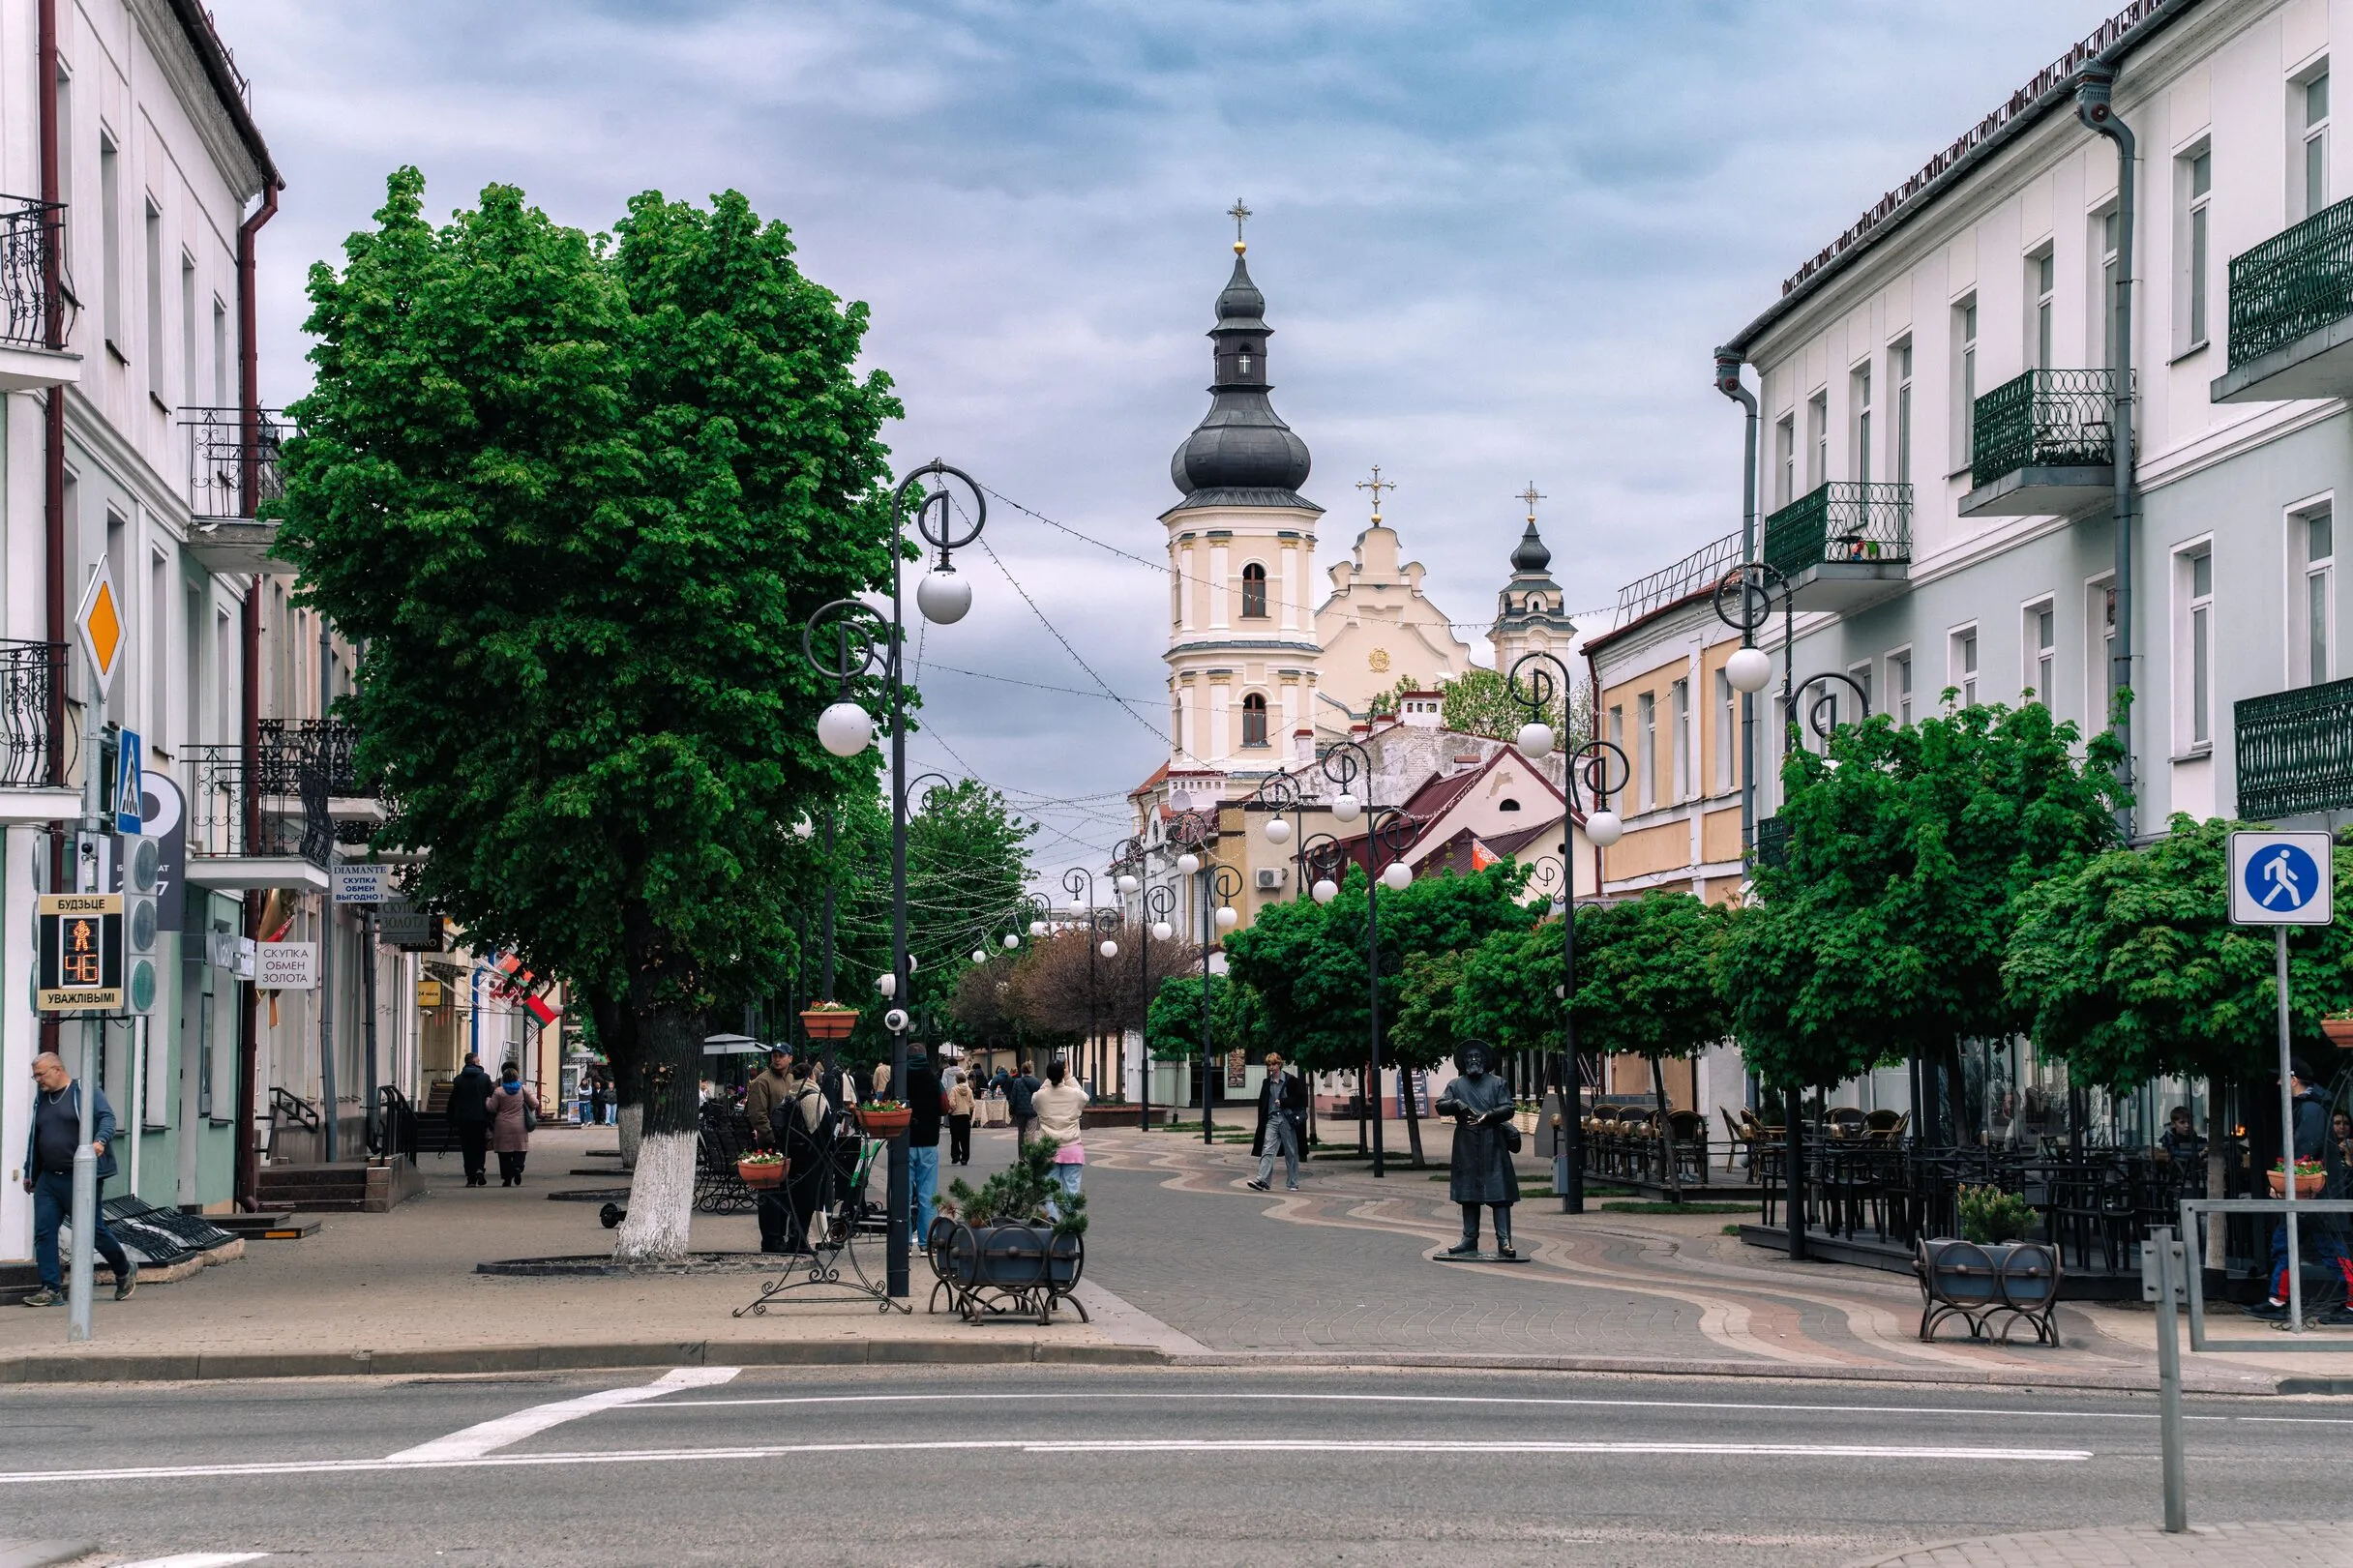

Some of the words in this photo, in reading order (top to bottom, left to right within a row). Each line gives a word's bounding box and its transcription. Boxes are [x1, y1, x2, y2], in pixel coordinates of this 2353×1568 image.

[58, 899, 105, 910] БУДЗЬЦЕ
[383, 917, 427, 929] ЗОЛОТА
[263, 949, 310, 959] СКУПКА
[65, 954, 98, 981] 46
[265, 962, 306, 970] ОБМЕН
[262, 973, 308, 983] ЗОЛОТА
[47, 992, 115, 1004] УВАЖЛІВЫМІ
